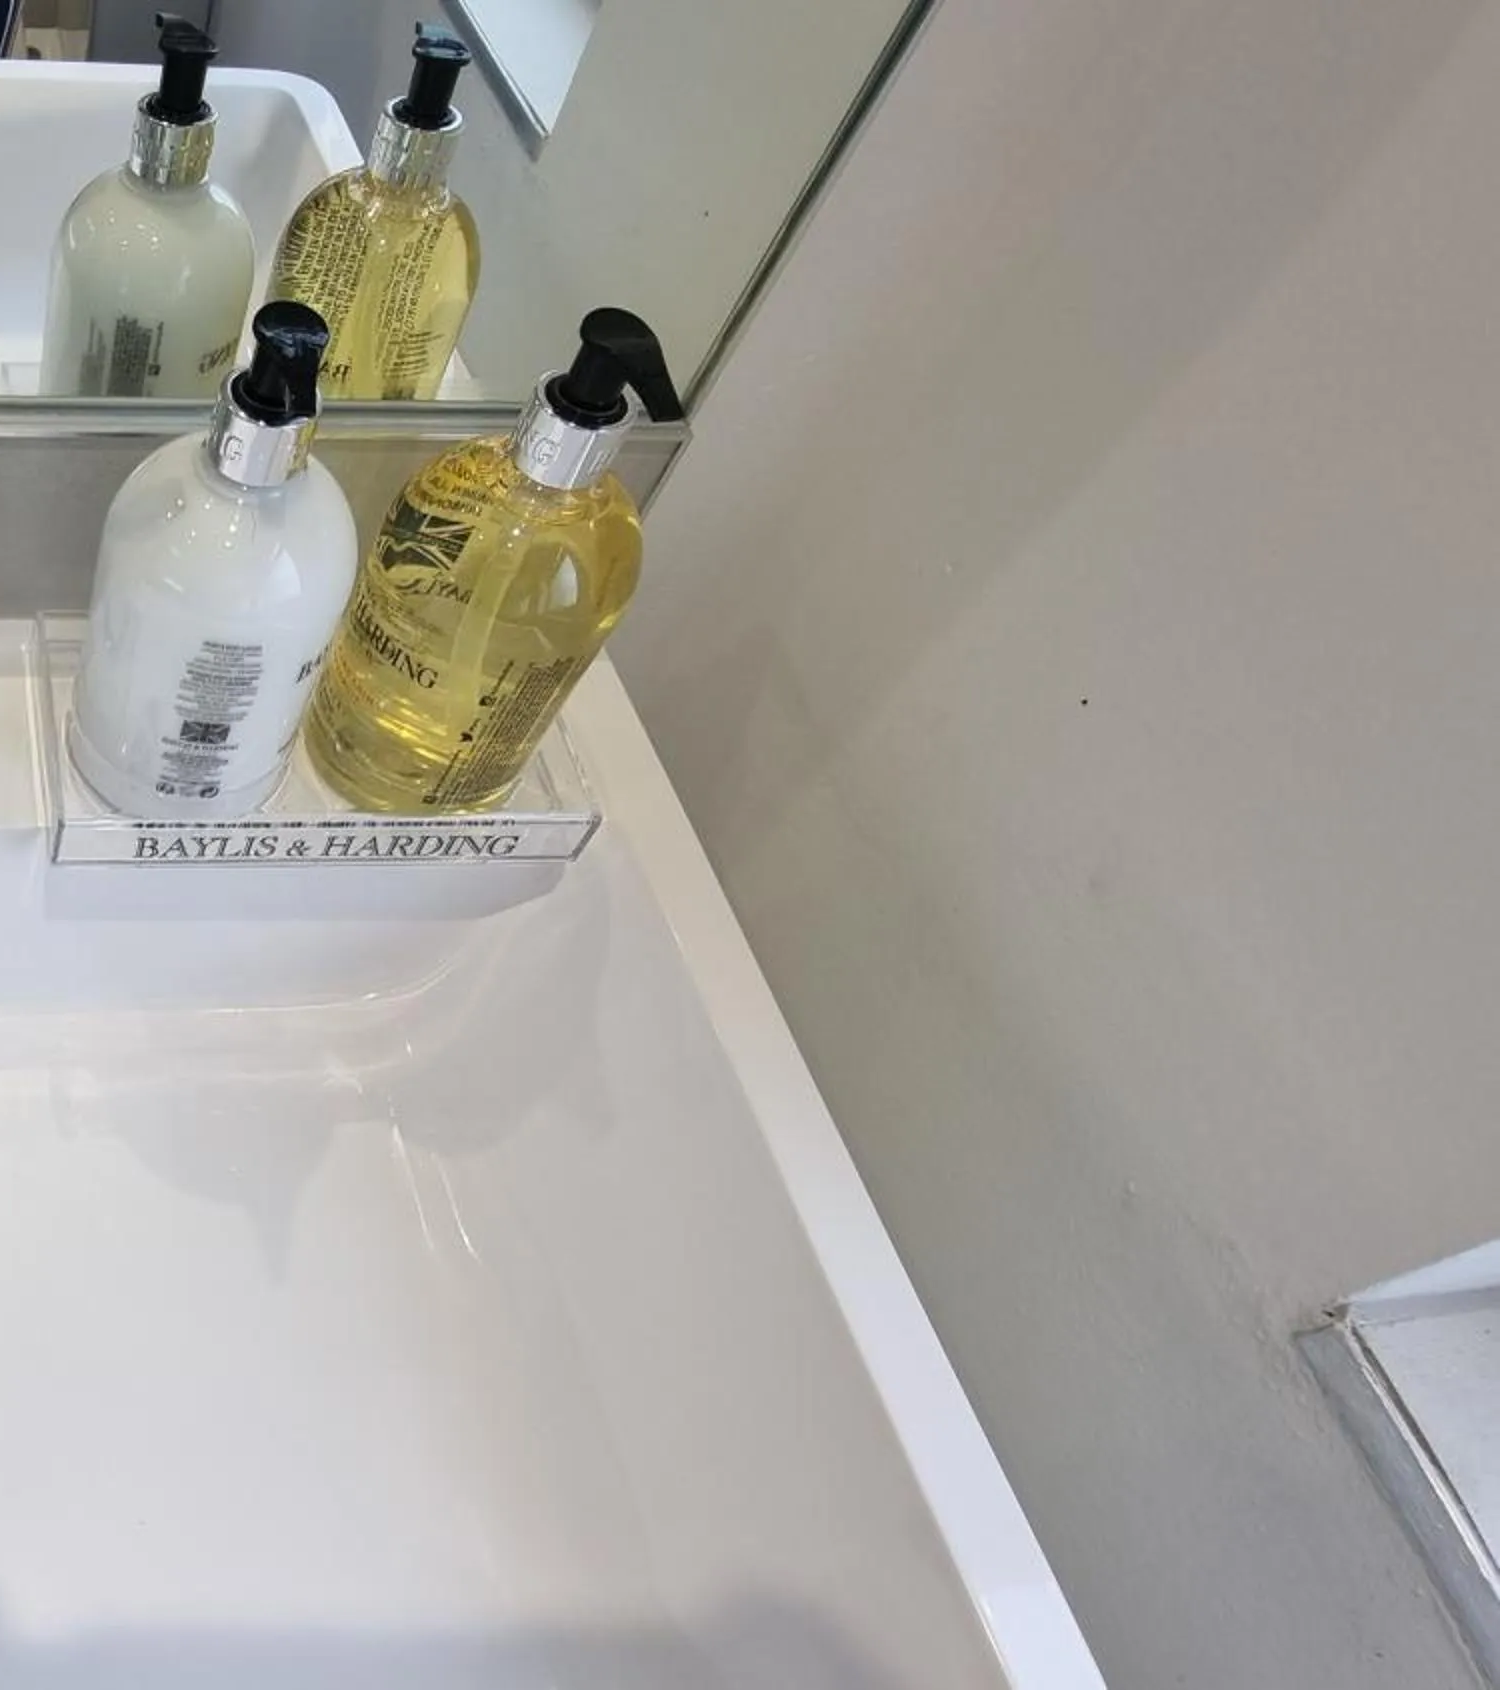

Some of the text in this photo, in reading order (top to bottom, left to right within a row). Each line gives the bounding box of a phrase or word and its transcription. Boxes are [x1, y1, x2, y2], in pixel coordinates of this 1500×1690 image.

[354, 592, 439, 689] HARDING
[133, 834, 520, 858] BAYLIS & HARDING
